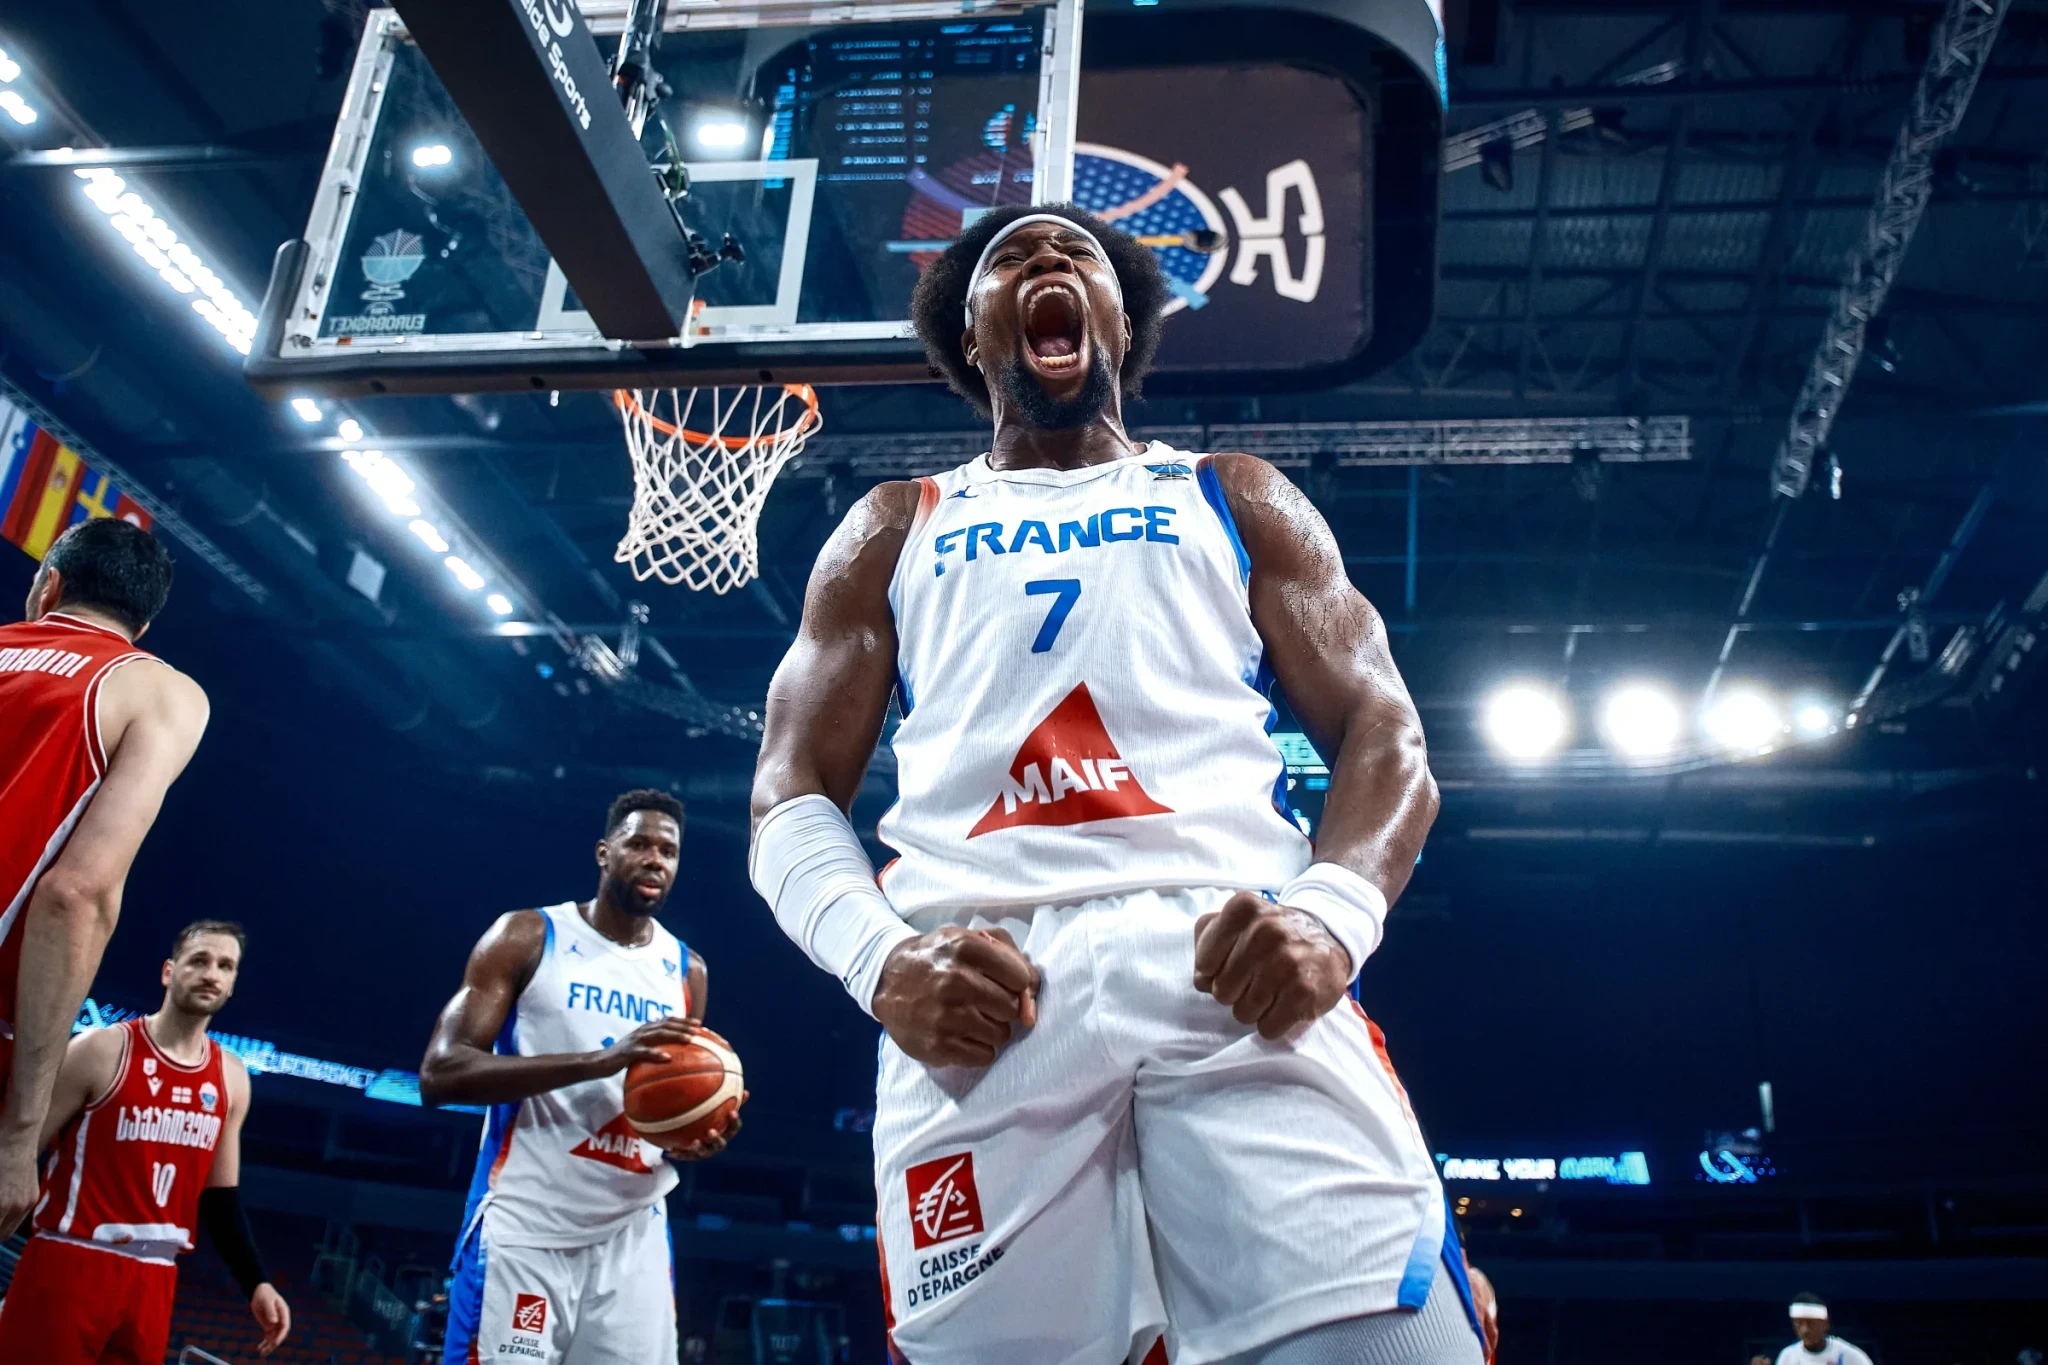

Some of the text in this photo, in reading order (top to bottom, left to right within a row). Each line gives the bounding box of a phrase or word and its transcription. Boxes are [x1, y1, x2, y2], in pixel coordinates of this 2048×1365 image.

[548, 42, 591, 130] Sports
[935, 506, 1180, 578] FRANCE
[1025, 579, 1082, 654] 7
[1000, 756, 1129, 816] MAIF
[586, 1132, 641, 1159] MAIF
[152, 1161, 177, 1208] 10
[907, 1247, 1005, 1308] D'EPARGNE
[919, 1243, 981, 1279] CAISSE
[511, 1335, 540, 1349] CAISSE
